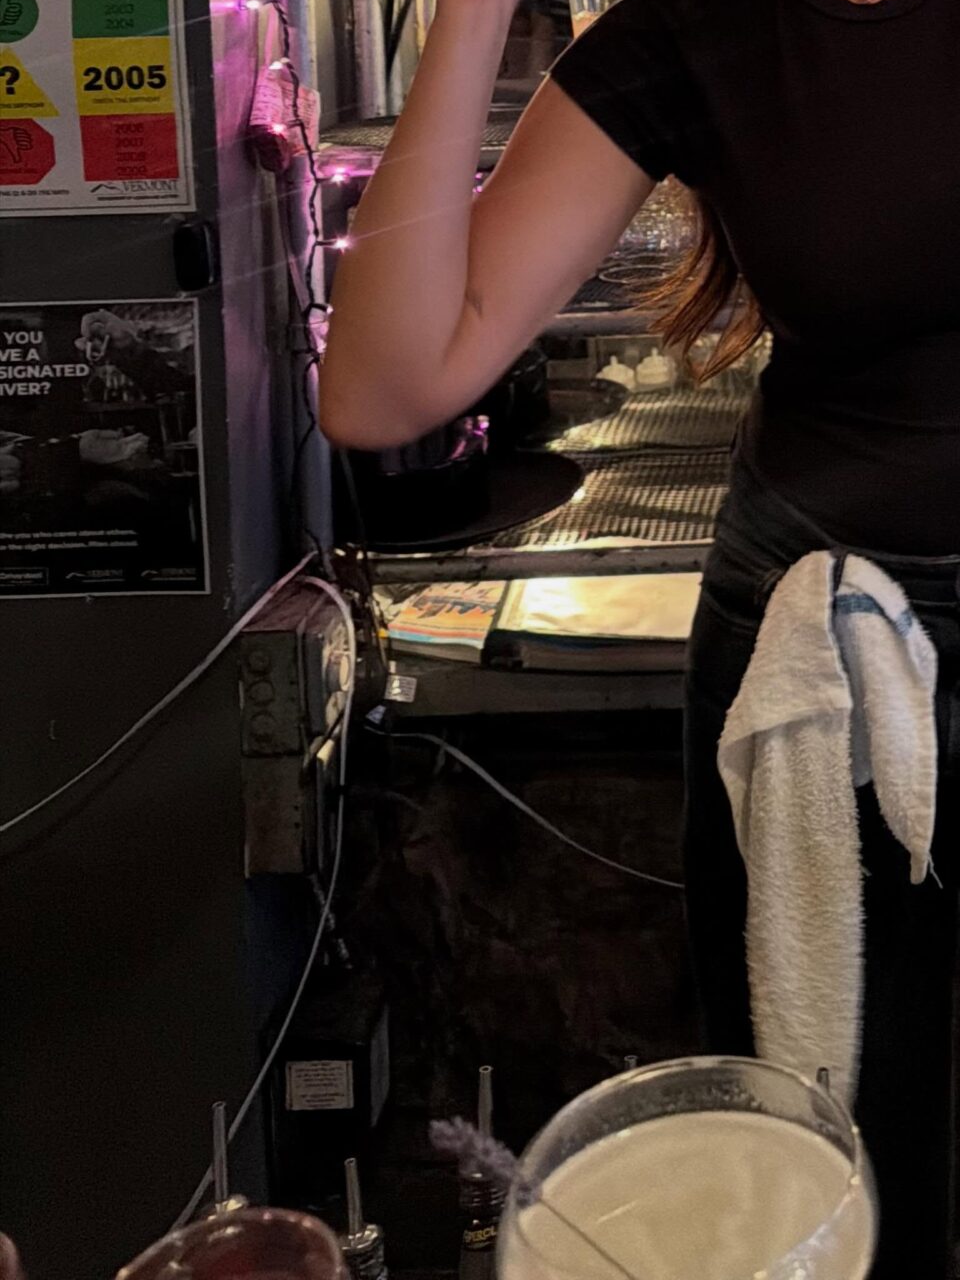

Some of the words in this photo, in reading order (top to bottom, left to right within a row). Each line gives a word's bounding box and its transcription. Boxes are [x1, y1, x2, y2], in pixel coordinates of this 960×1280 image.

[83, 64, 167, 92] 2005
[122, 180, 179, 193] VERMONT
[4, 330, 43, 345] YOU
[0, 348, 23, 362] VE
[25, 347, 40, 361] A
[0, 363, 90, 379] SIGNATED
